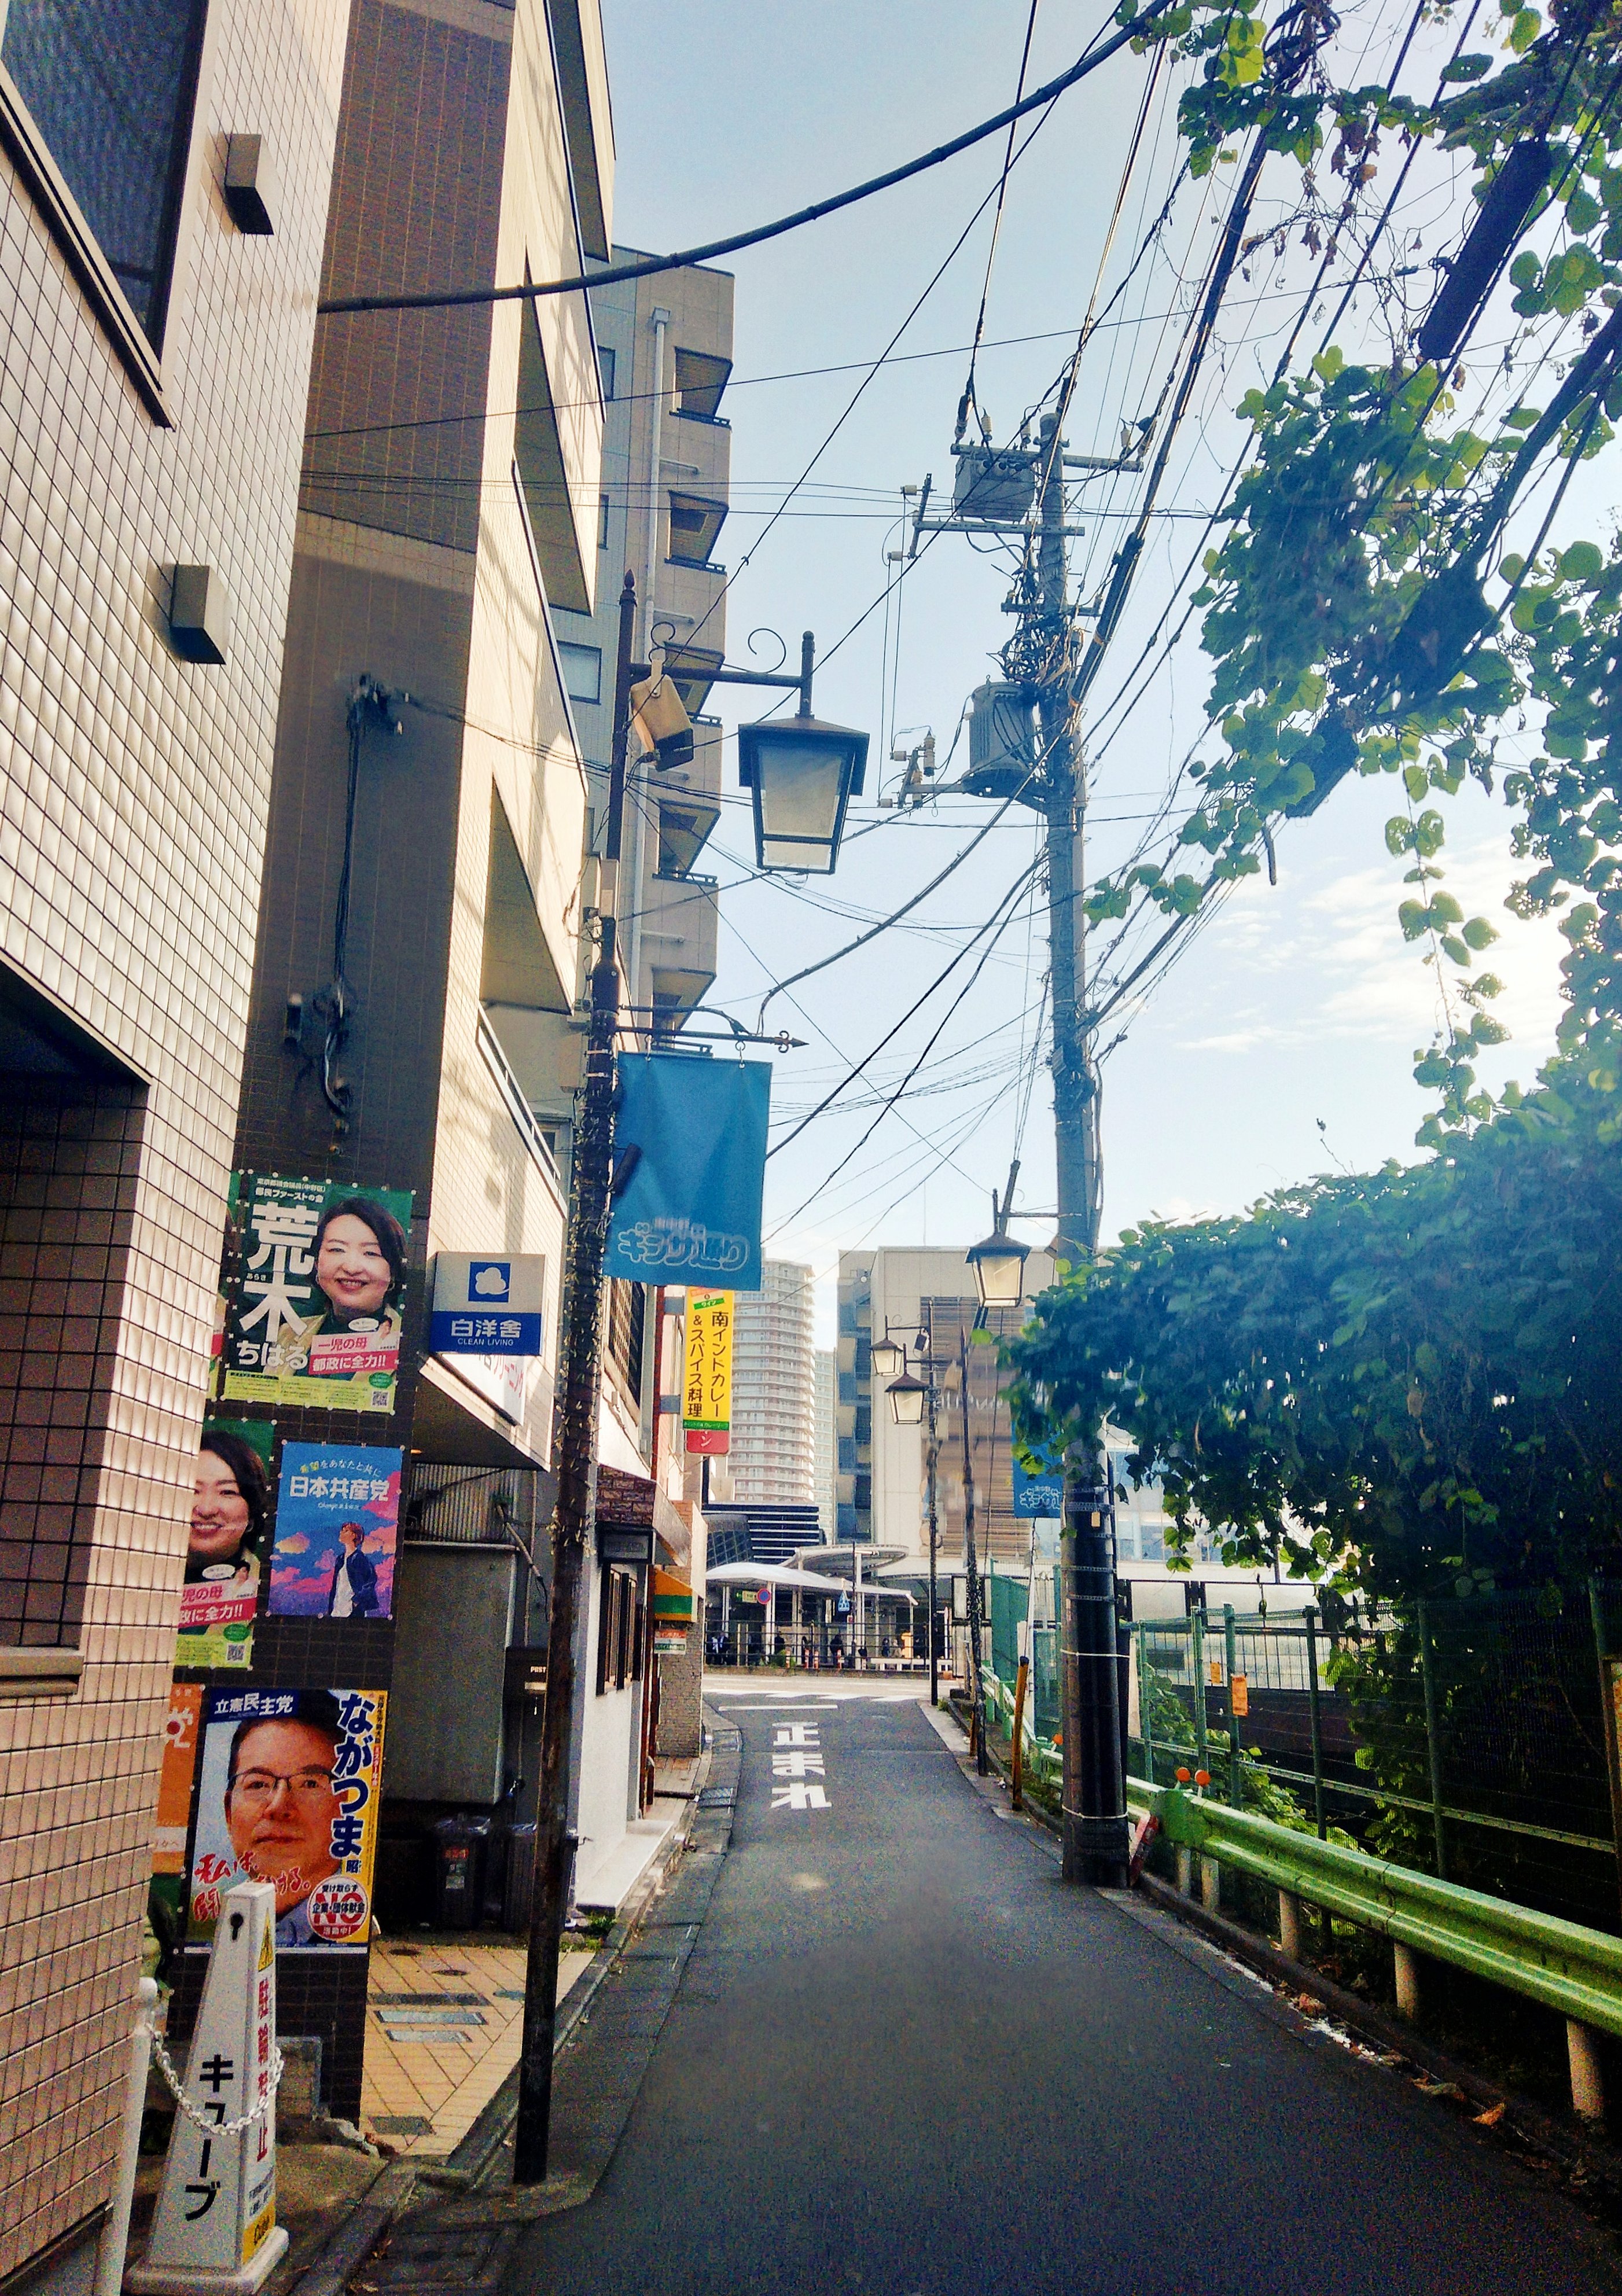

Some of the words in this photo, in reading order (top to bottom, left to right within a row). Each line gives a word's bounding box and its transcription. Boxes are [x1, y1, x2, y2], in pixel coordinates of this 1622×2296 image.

[238, 1201, 319, 1342] 荒木
[236, 1340, 308, 1370] ちはる
[318, 1337, 367, 1351] 一児の母
[458, 1338, 484, 1346] CLEAN
[687, 1315, 705, 1418] &スパイス料理
[711, 1311, 729, 1418] 南インドカレー
[300, 1459, 382, 1477] 希望をあなたと共に
[290, 1475, 390, 1502] 日本共産党
[182, 1585, 223, 1603] 児の母
[181, 1604, 244, 1624] 政に全力!!
[214, 1692, 294, 1716] 立憲民主党
[329, 1692, 376, 1860] ながつま
[770, 1721, 832, 1809] 止まれ
